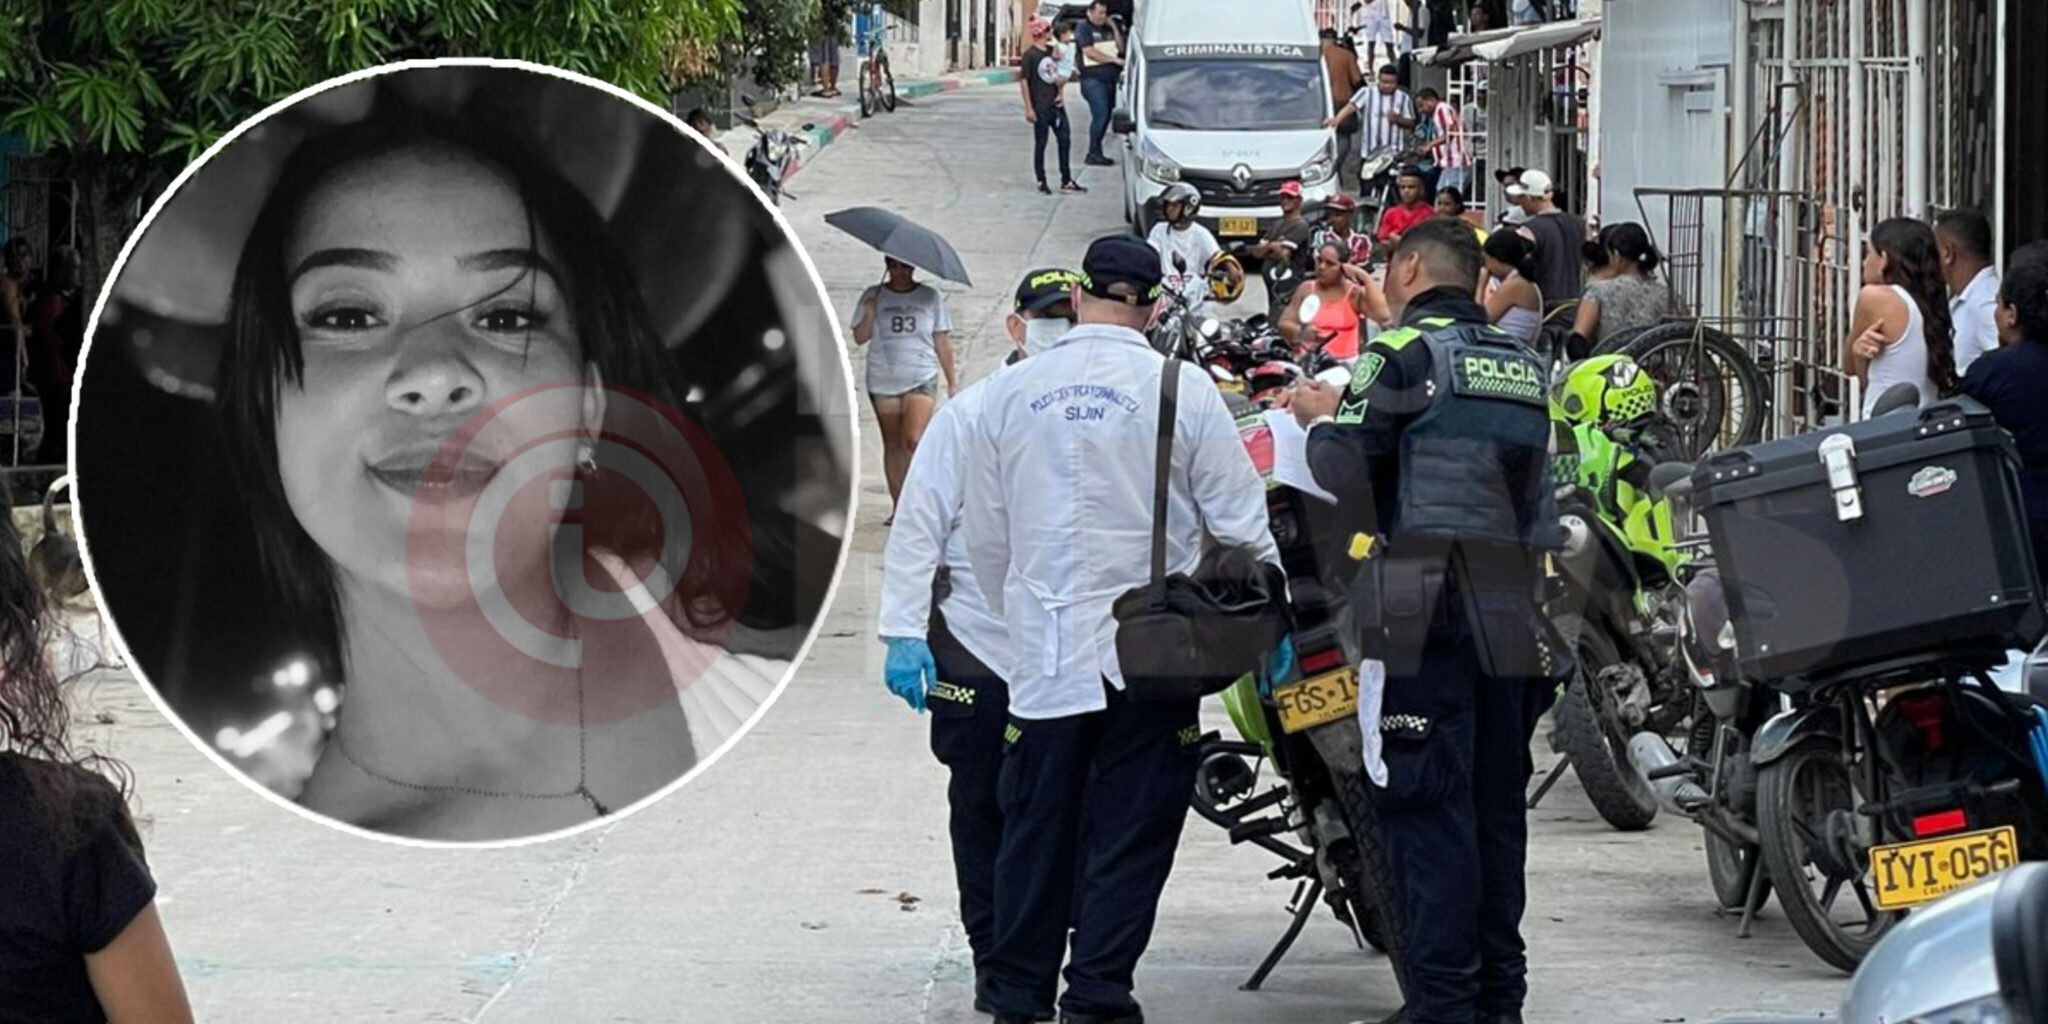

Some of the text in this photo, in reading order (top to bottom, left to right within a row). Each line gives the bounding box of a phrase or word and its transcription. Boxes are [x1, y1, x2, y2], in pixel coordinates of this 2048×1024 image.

[1163, 43, 1304, 57] CRIMINALISTICA
[891, 315, 917, 333] 83
[1065, 406, 1104, 420] SIJIN
